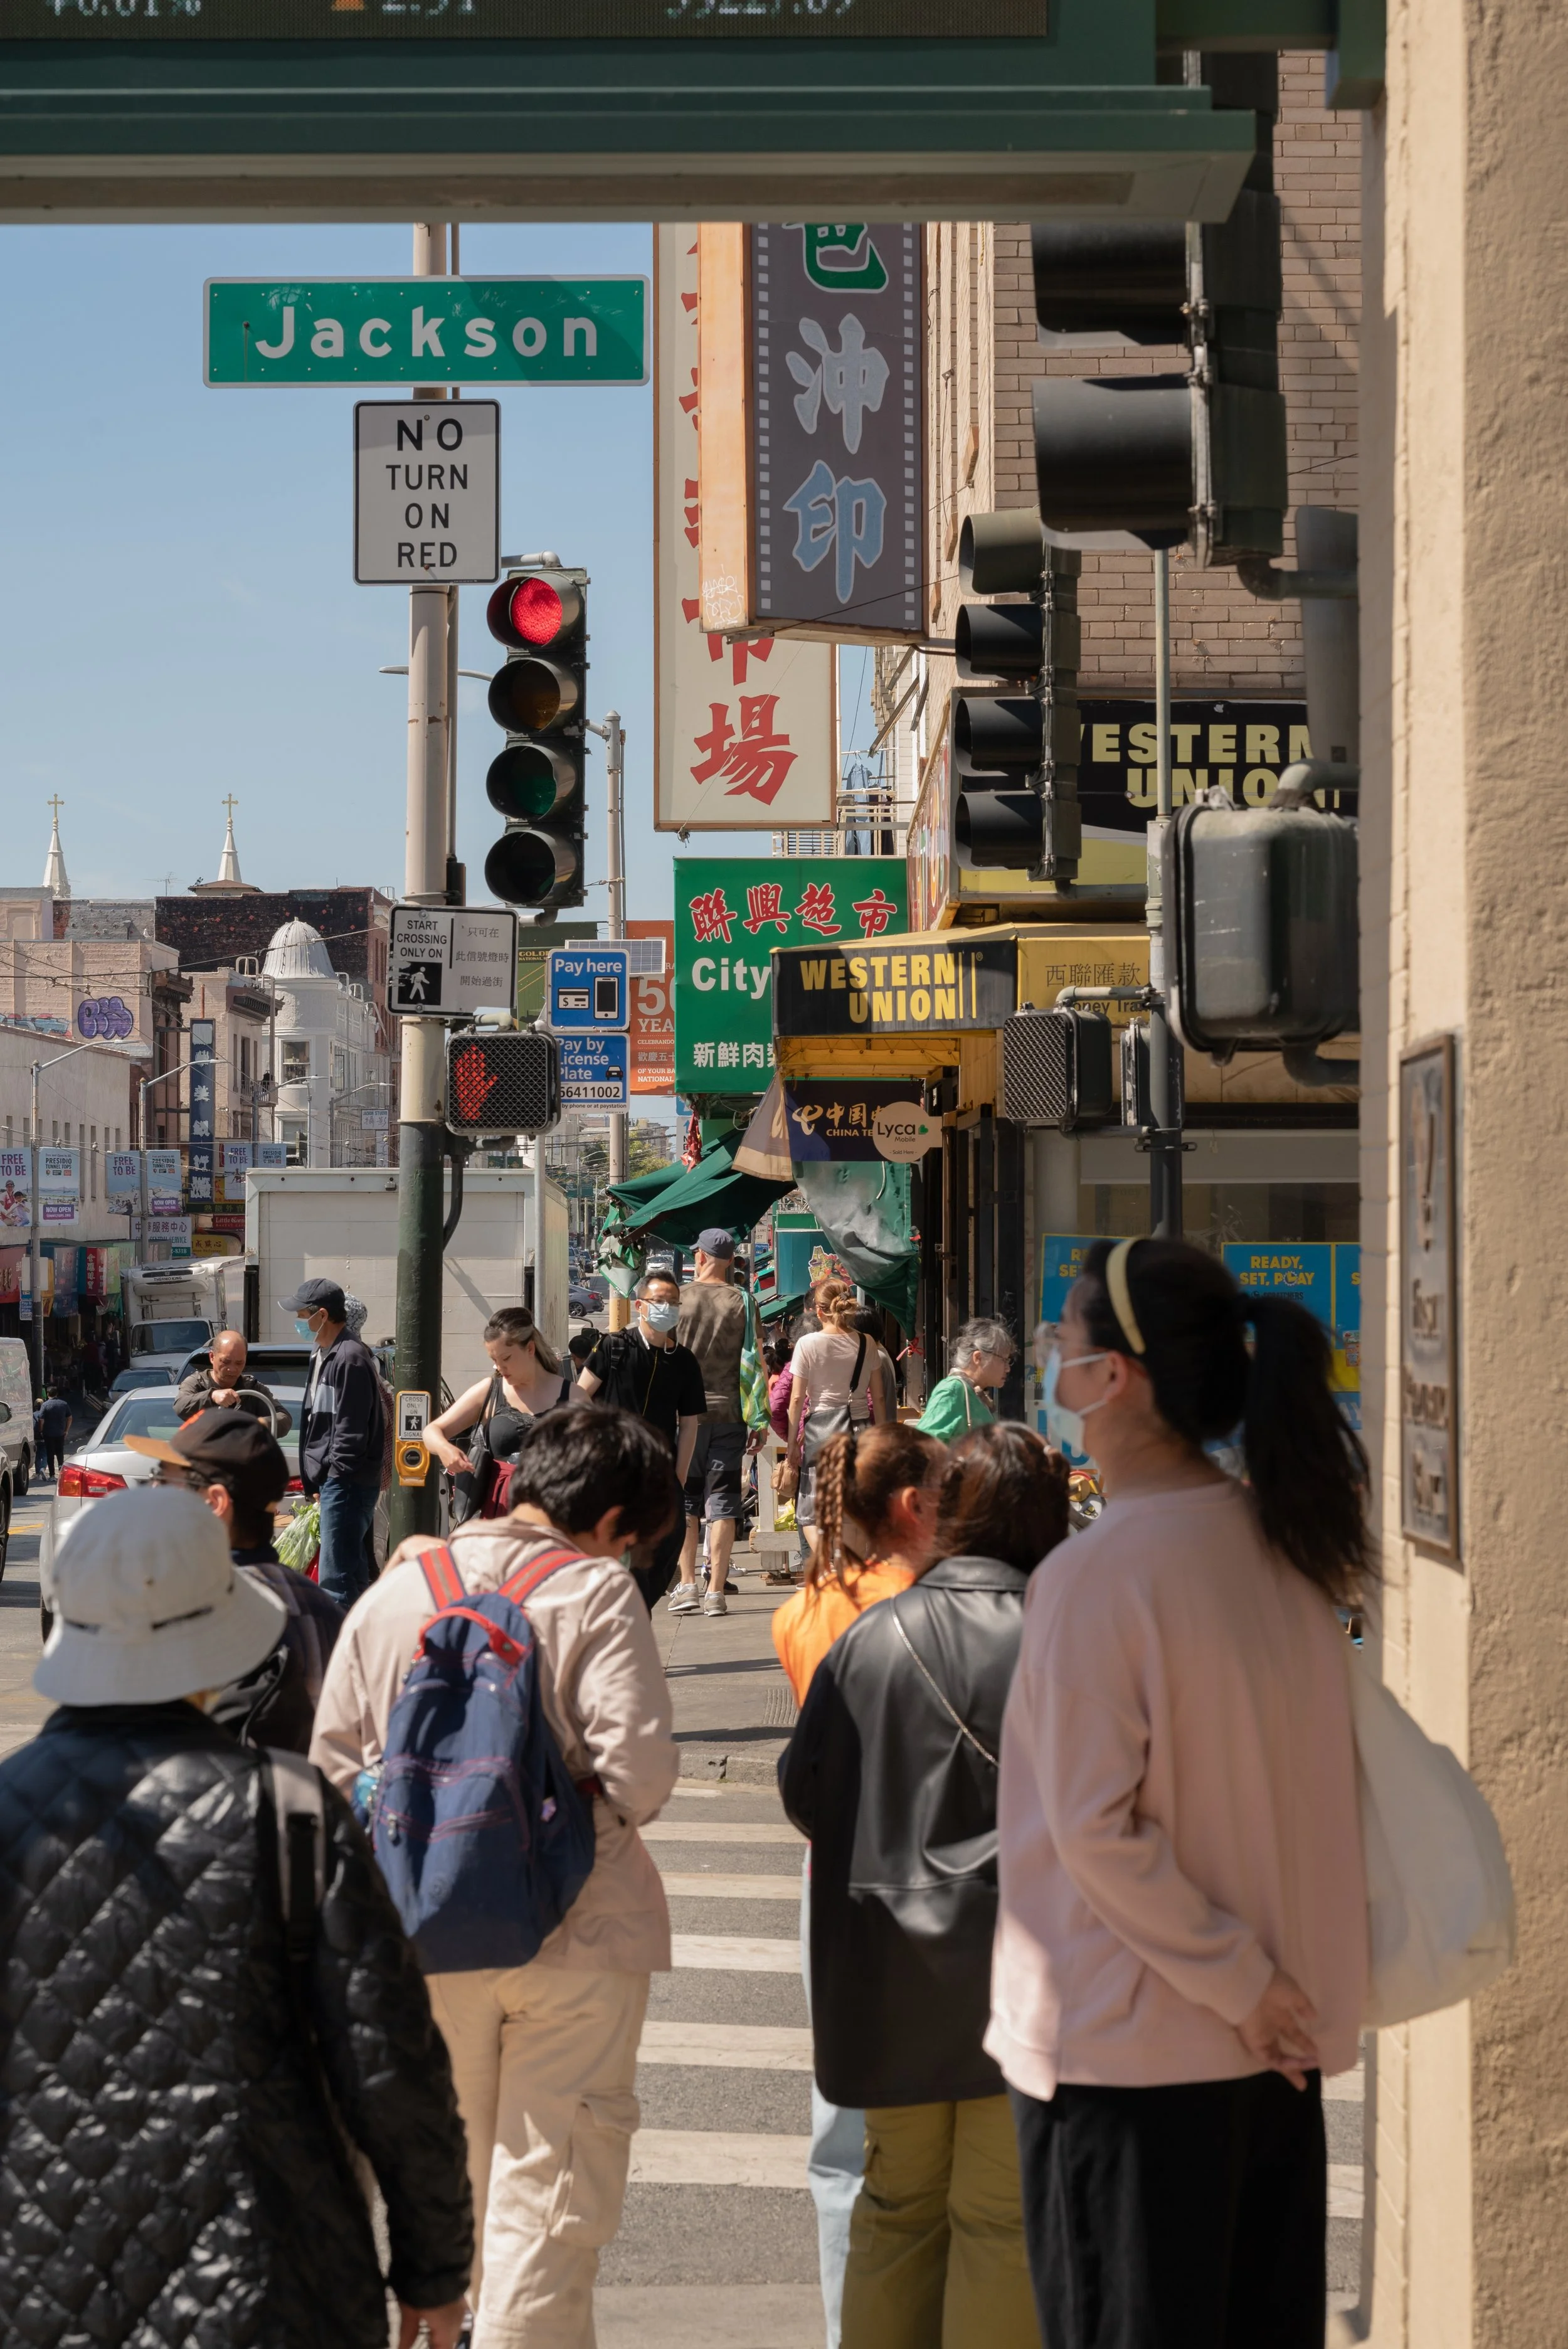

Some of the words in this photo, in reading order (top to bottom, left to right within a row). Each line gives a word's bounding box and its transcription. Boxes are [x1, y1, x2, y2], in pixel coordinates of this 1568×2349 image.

[255, 305, 597, 358] Jackson
[396, 418, 463, 452] NO
[386, 464, 468, 490] TURN
[405, 503, 449, 529] ON
[397, 542, 457, 568] RED
[1080, 723, 1315, 763] ESTERN
[407, 920, 438, 931] START
[467, 927, 499, 938] 只可在
[397, 933, 447, 945] CROSSING
[400, 947, 426, 958] ONLY
[428, 948, 442, 958] ON
[455, 951, 509, 963] 此信號燈時
[555, 958, 584, 976] Pay
[586, 958, 622, 972] here
[800, 953, 956, 990] WESTERN
[1045, 962, 1141, 987] 西聯匯款
[460, 975, 503, 987] 開始過街
[692, 957, 771, 999] City
[849, 989, 956, 1024] UNION
[586, 1037, 605, 1054] by
[561, 1053, 609, 1065] icense
[877, 1122, 916, 1138] Lyca
[2, 1153, 23, 1164] FREE
[114, 1157, 133, 1165] FREE
[0, 1165, 12, 1176] TO
[15, 1165, 26, 1176] BE
[113, 1167, 123, 1175] TO
[126, 1165, 135, 1175] BE
[1251, 1256, 1303, 1269] READY,
[1239, 1272, 1269, 1286] SET,
[1274, 1272, 1315, 1285] PLAY
